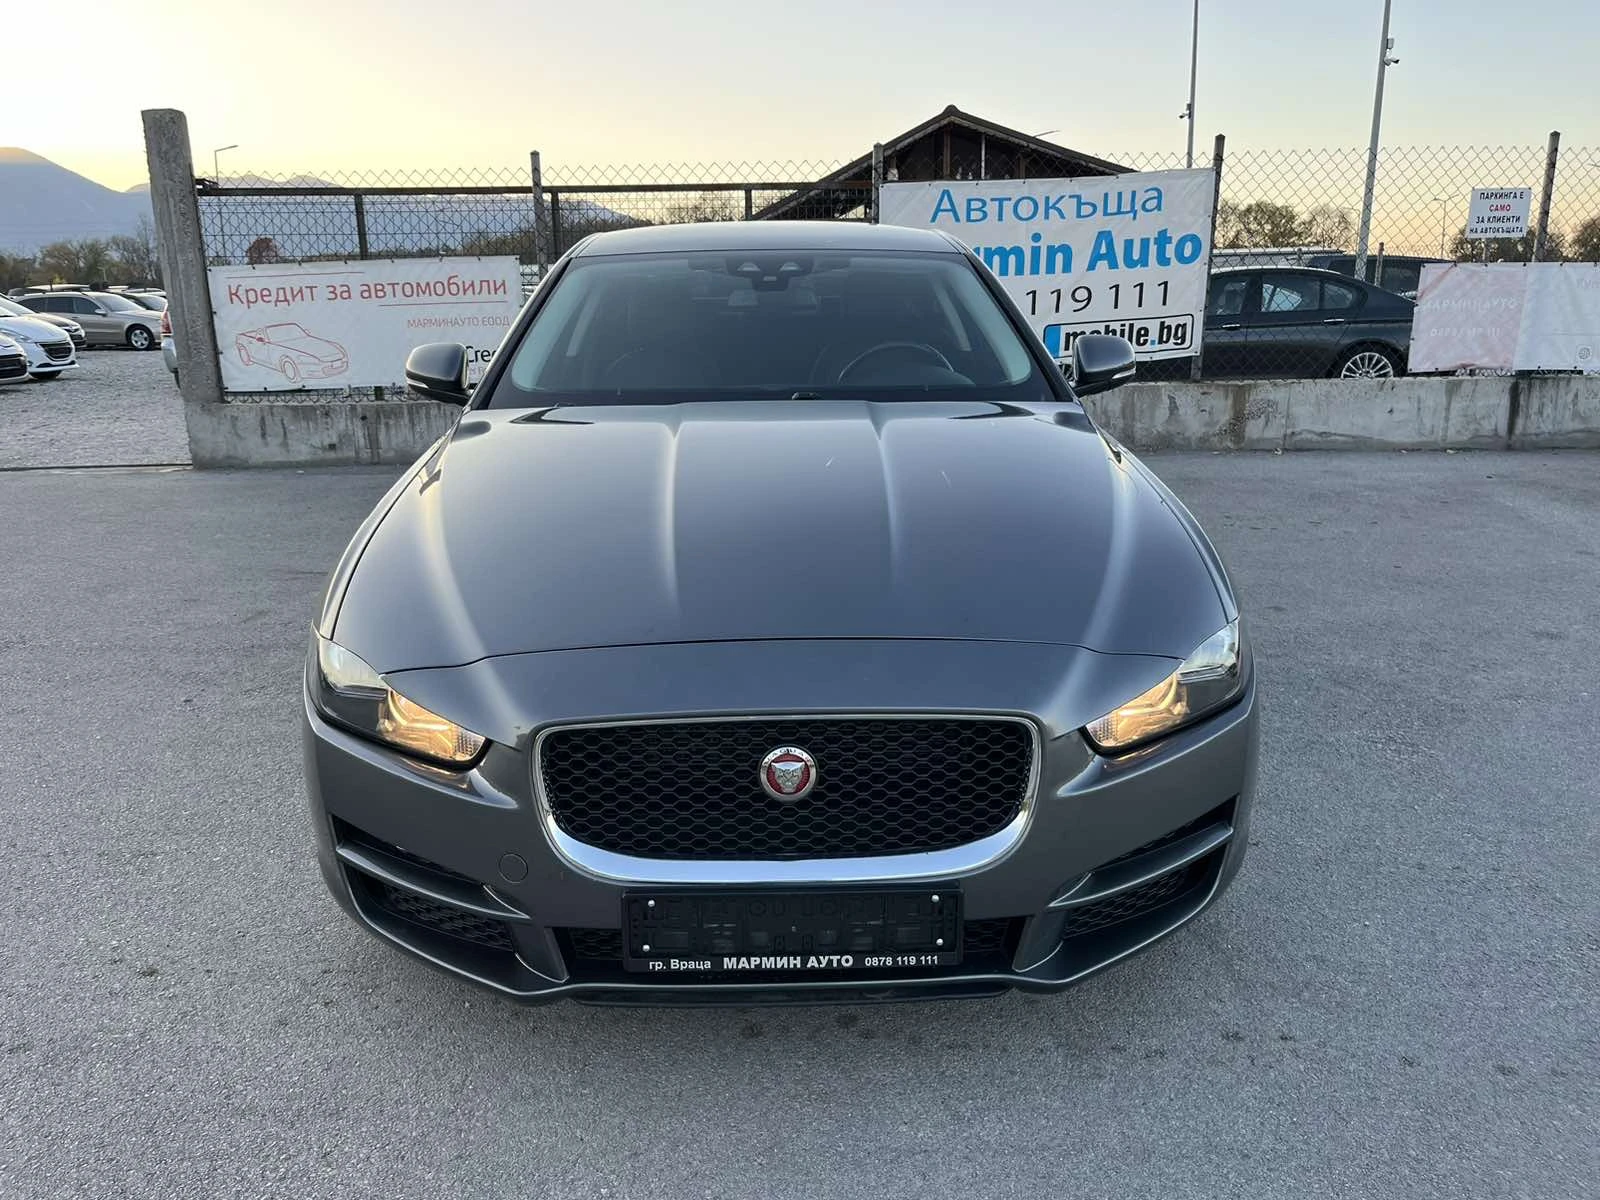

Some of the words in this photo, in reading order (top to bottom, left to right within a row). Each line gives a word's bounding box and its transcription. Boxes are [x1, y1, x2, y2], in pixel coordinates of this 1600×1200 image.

[930, 186, 1163, 223] Автокъща
[1480, 191, 1517, 200] ПАРКИНГА
[1520, 191, 1524, 199] Е
[1489, 204, 1511, 212] САМО
[1476, 216, 1485, 224] ЗА
[1487, 216, 1521, 224] КЛИЕНТИ
[1480, 226, 1523, 234] АВТОКЪЩАТА
[1086, 228, 1203, 272] Auto
[228, 284, 318, 309] Кредит
[326, 284, 353, 301] за
[360, 275, 508, 299] автомобили
[1025, 285, 1093, 316] 119
[1108, 280, 1170, 310] 111
[1064, 320, 1188, 351] mile.bg
[465, 345, 497, 364] Cre
[649, 961, 667, 971] гр.
[670, 959, 712, 971] Враца
[723, 956, 801, 969] МАРМИН
[806, 955, 854, 968] АУТО
[864, 957, 893, 967] 0878
[896, 956, 917, 966] 119
[919, 955, 939, 965] 111
